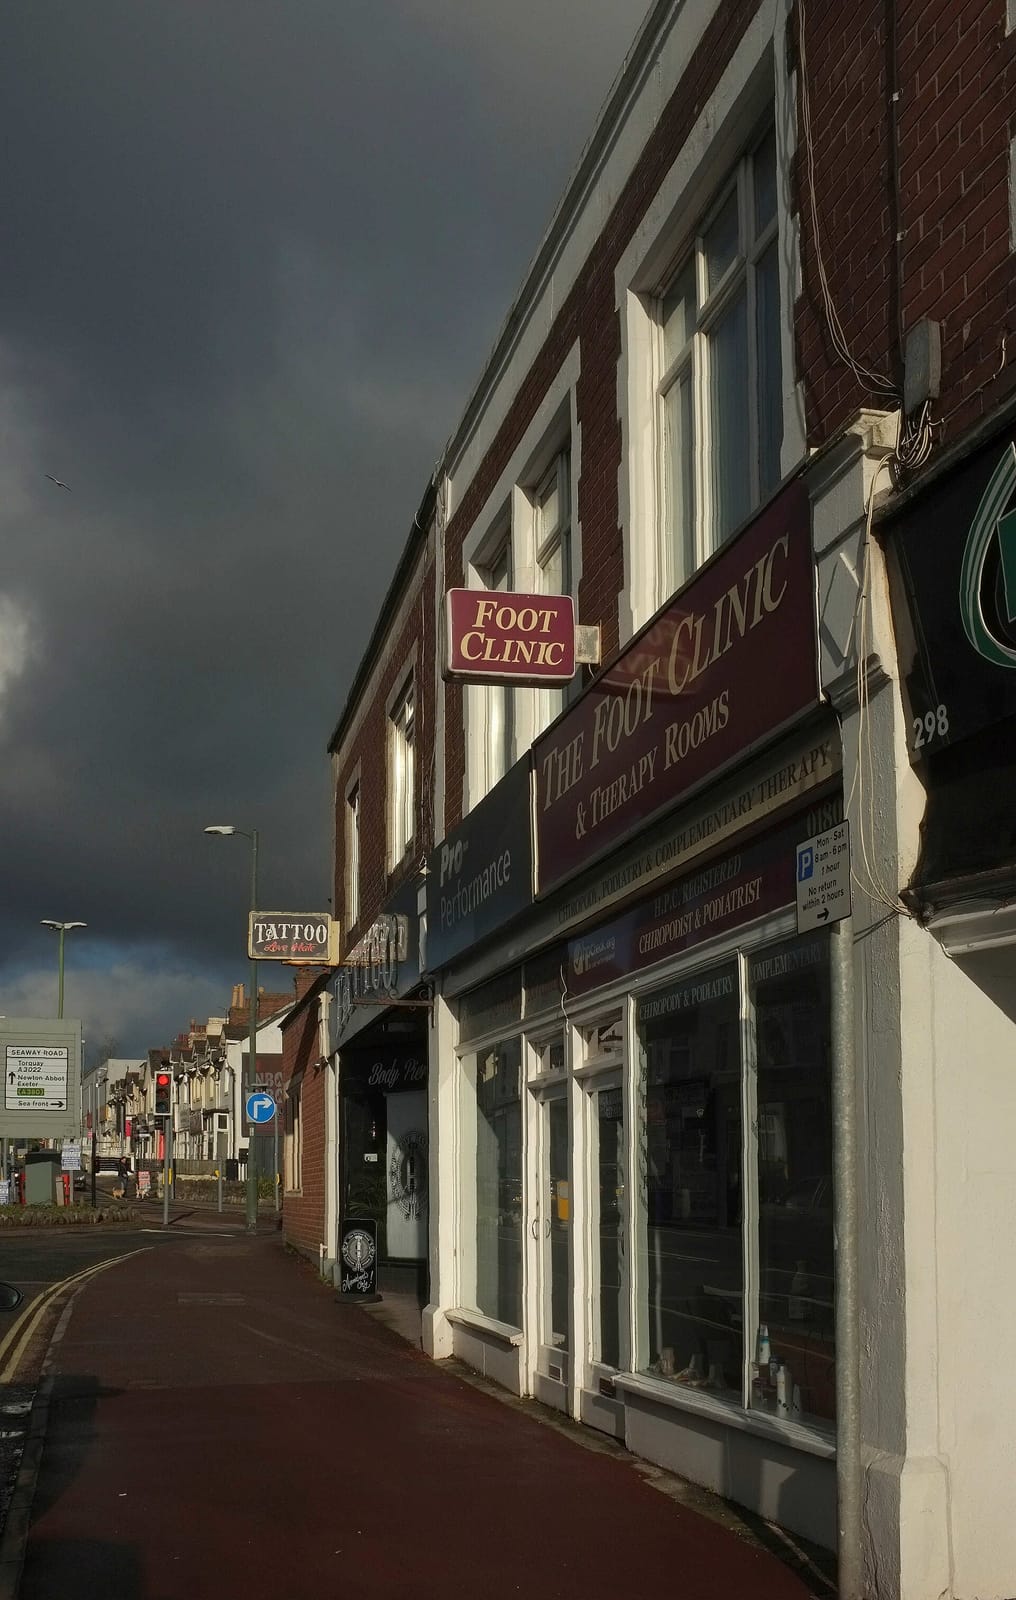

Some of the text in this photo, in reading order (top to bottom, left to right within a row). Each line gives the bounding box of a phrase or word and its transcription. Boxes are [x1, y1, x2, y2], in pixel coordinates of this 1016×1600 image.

[471, 600, 558, 633] FOOT
[460, 631, 565, 666] CLINIC
[543, 532, 789, 812] THE FOOT CLINIC
[913, 704, 949, 749] 298
[575, 689, 729, 840] & THERAPY ROOMS
[602, 859, 645, 898] PODIATRY
[644, 857, 651, 873] &
[655, 792, 756, 869] COMPLEMENTARY
[757, 742, 830, 805] THERAPY
[816, 837, 829, 849] Mon
[833, 828, 844, 841] Sat
[440, 840, 462, 888] Pro
[681, 855, 741, 905] REGISTERED
[826, 862, 840, 873] hour
[440, 850, 511, 932] Performance
[802, 888, 845, 911] within 2 hours
[808, 879, 837, 897] No return
[254, 923, 328, 944] TATTOO
[639, 876, 762, 954] CHIROPODIST & PODIATRIST
[640, 975, 735, 1020] CHIROPODY & PODIATRY
[367, 1057, 399, 1088] Body
